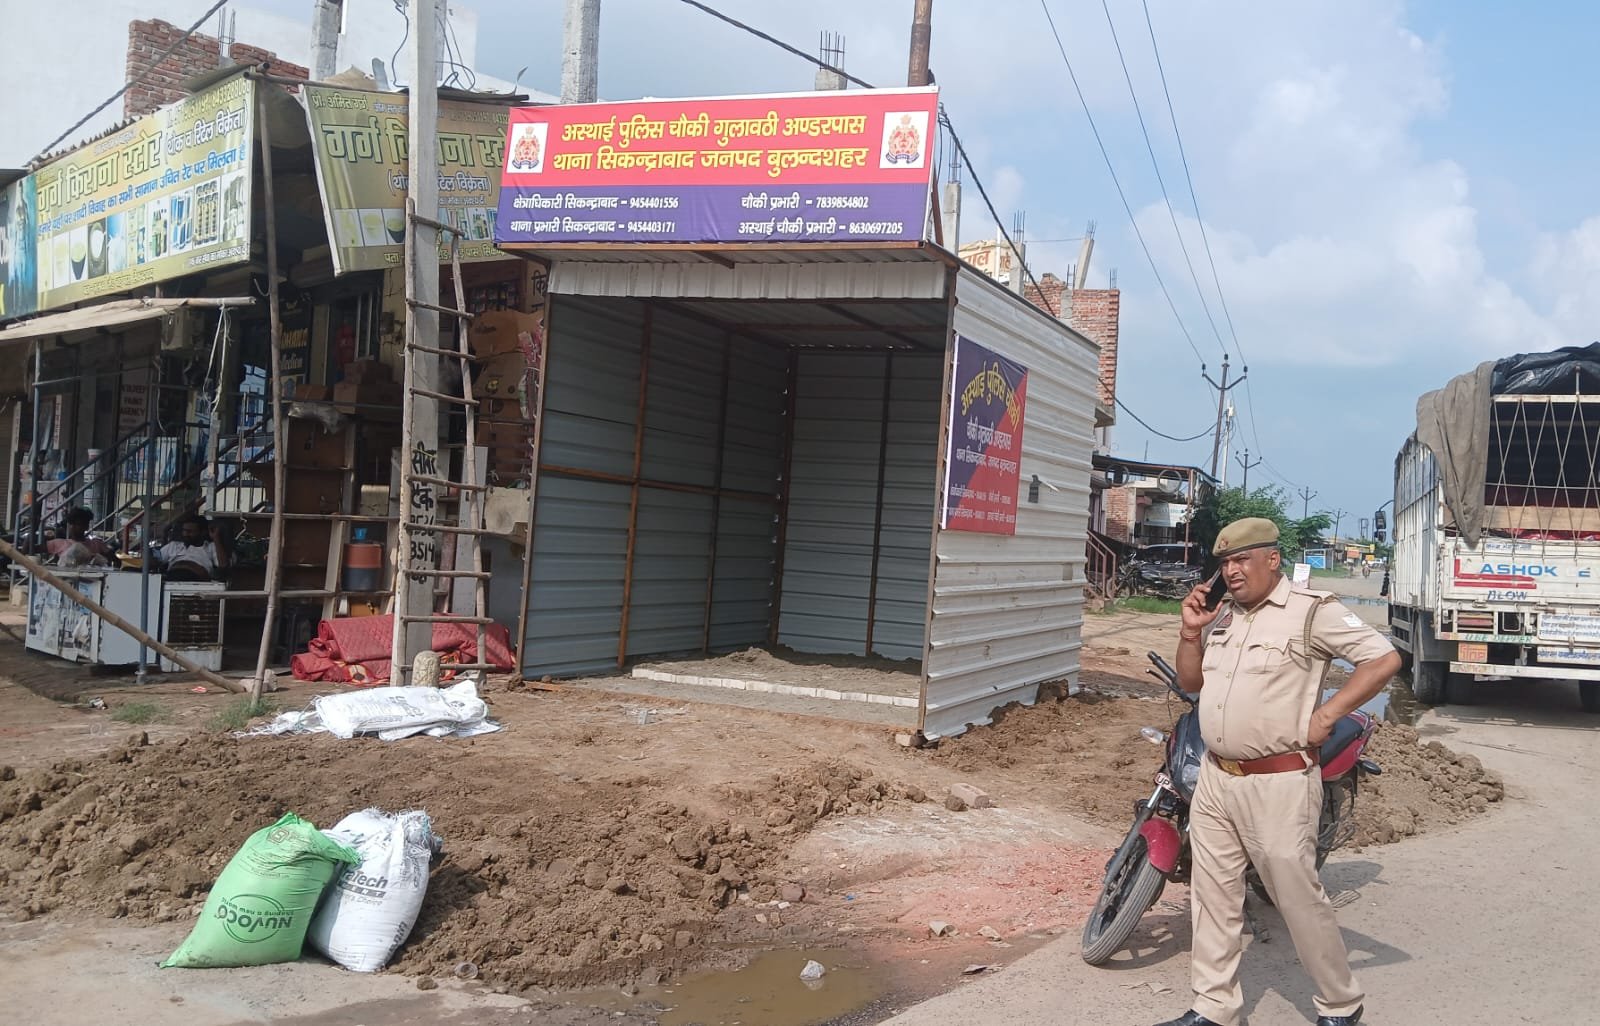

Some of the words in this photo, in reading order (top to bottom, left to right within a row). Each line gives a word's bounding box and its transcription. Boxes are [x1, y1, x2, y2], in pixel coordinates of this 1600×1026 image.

[561, 115, 617, 142] अस्थाई
[619, 113, 666, 148] पुलिस
[668, 112, 711, 138] चौकी
[713, 110, 780, 147] गुलावठी
[782, 115, 868, 137] अण्डरपास
[321, 116, 383, 164] गर्ग
[553, 152, 593, 171] थाना
[597, 145, 697, 172] सिकन्द्राबाद
[700, 150, 764, 168] जनपद
[767, 147, 870, 178] बुलन्दशहर
[565, 193, 619, 210] सिकन्द्राबाद
[629, 197, 679, 209] 9454401556
[741, 192, 768, 209] चौकी
[770, 191, 800, 211] प्रभारी
[816, 196, 869, 209] 7839854802
[510, 220, 534, 232] थाना
[534, 216, 560, 234] प्रभारी
[562, 216, 617, 234] सिकन्द्राबाद
[627, 221, 676, 233] 9454403171
[738, 216, 775, 235] अस्थाई
[777, 216, 804, 234] चौकी
[806, 216, 837, 236] प्रभारी
[849, 222, 903, 235] 8630697205
[1479, 563, 1558, 578] ASHOK
[217, 904, 293, 933] NUVOCO
